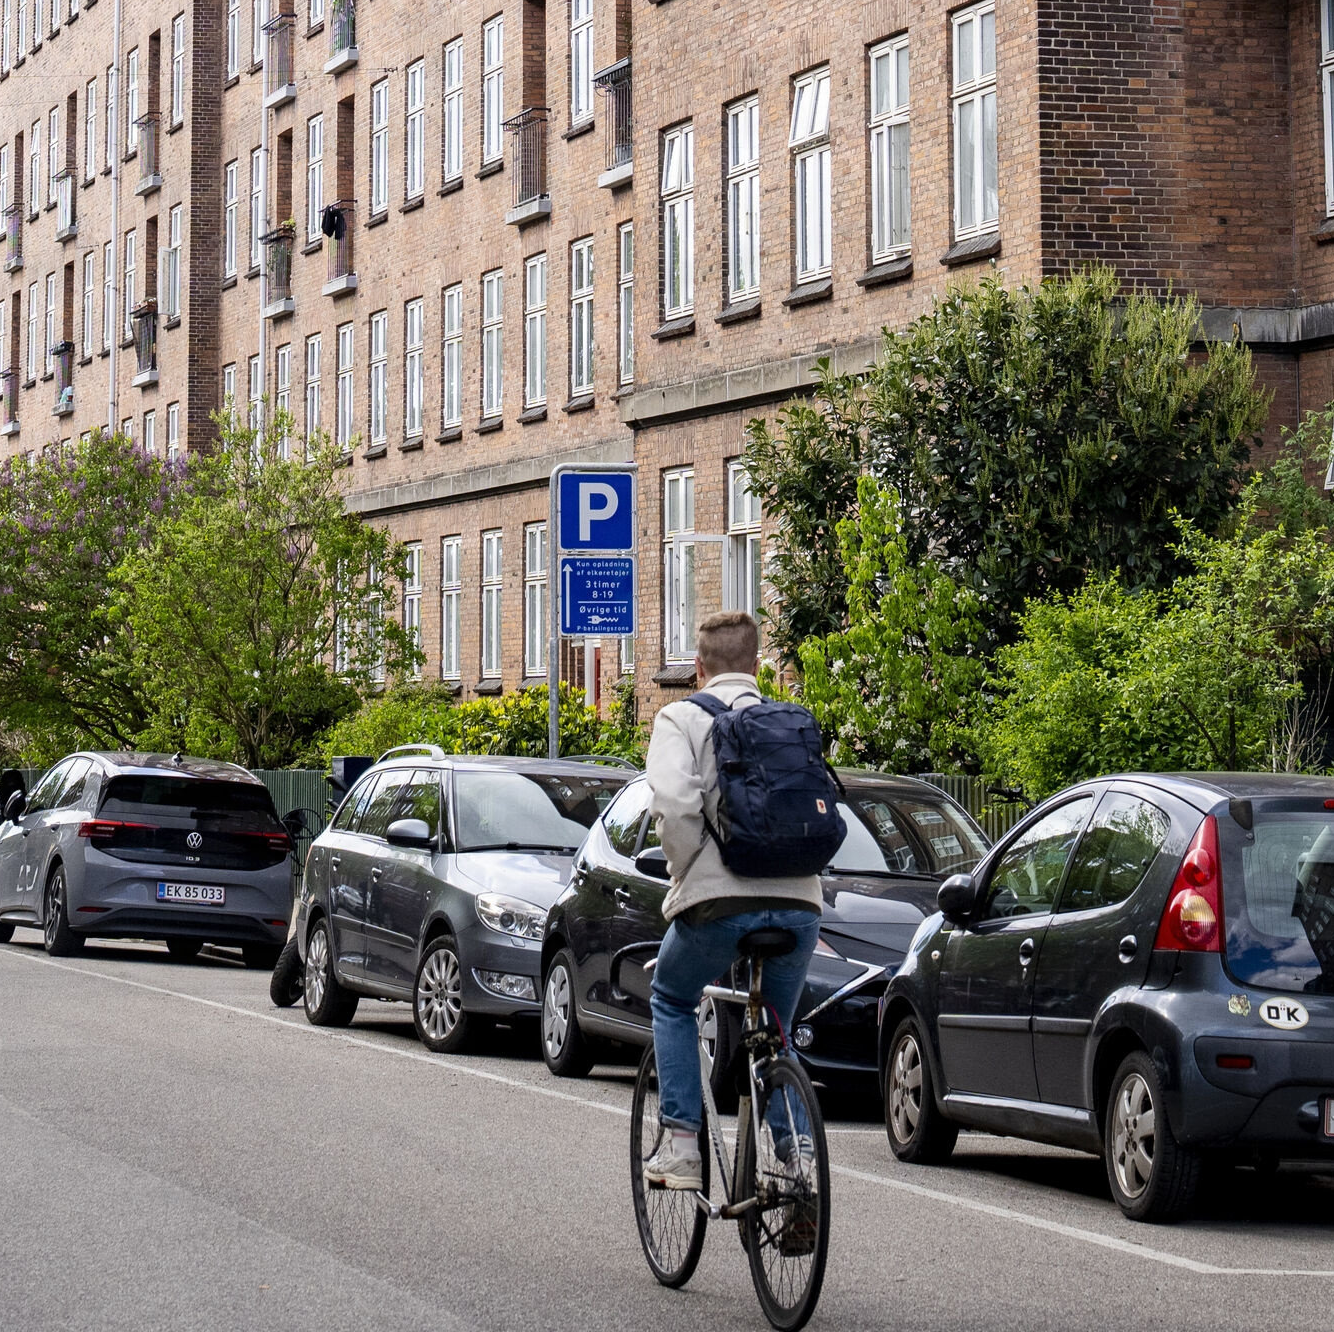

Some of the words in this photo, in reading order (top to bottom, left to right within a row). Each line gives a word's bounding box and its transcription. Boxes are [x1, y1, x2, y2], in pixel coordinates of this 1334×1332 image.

[579, 482, 619, 541] P
[585, 580, 591, 588] 3
[593, 580, 620, 588] timer
[592, 590, 614, 599] 8-19
[579, 605, 610, 615] Øvrige
[614, 605, 627, 613] tid
[166, 885, 182, 897] EK
[184, 886, 199, 898] 85
[201, 888, 223, 900] 033
